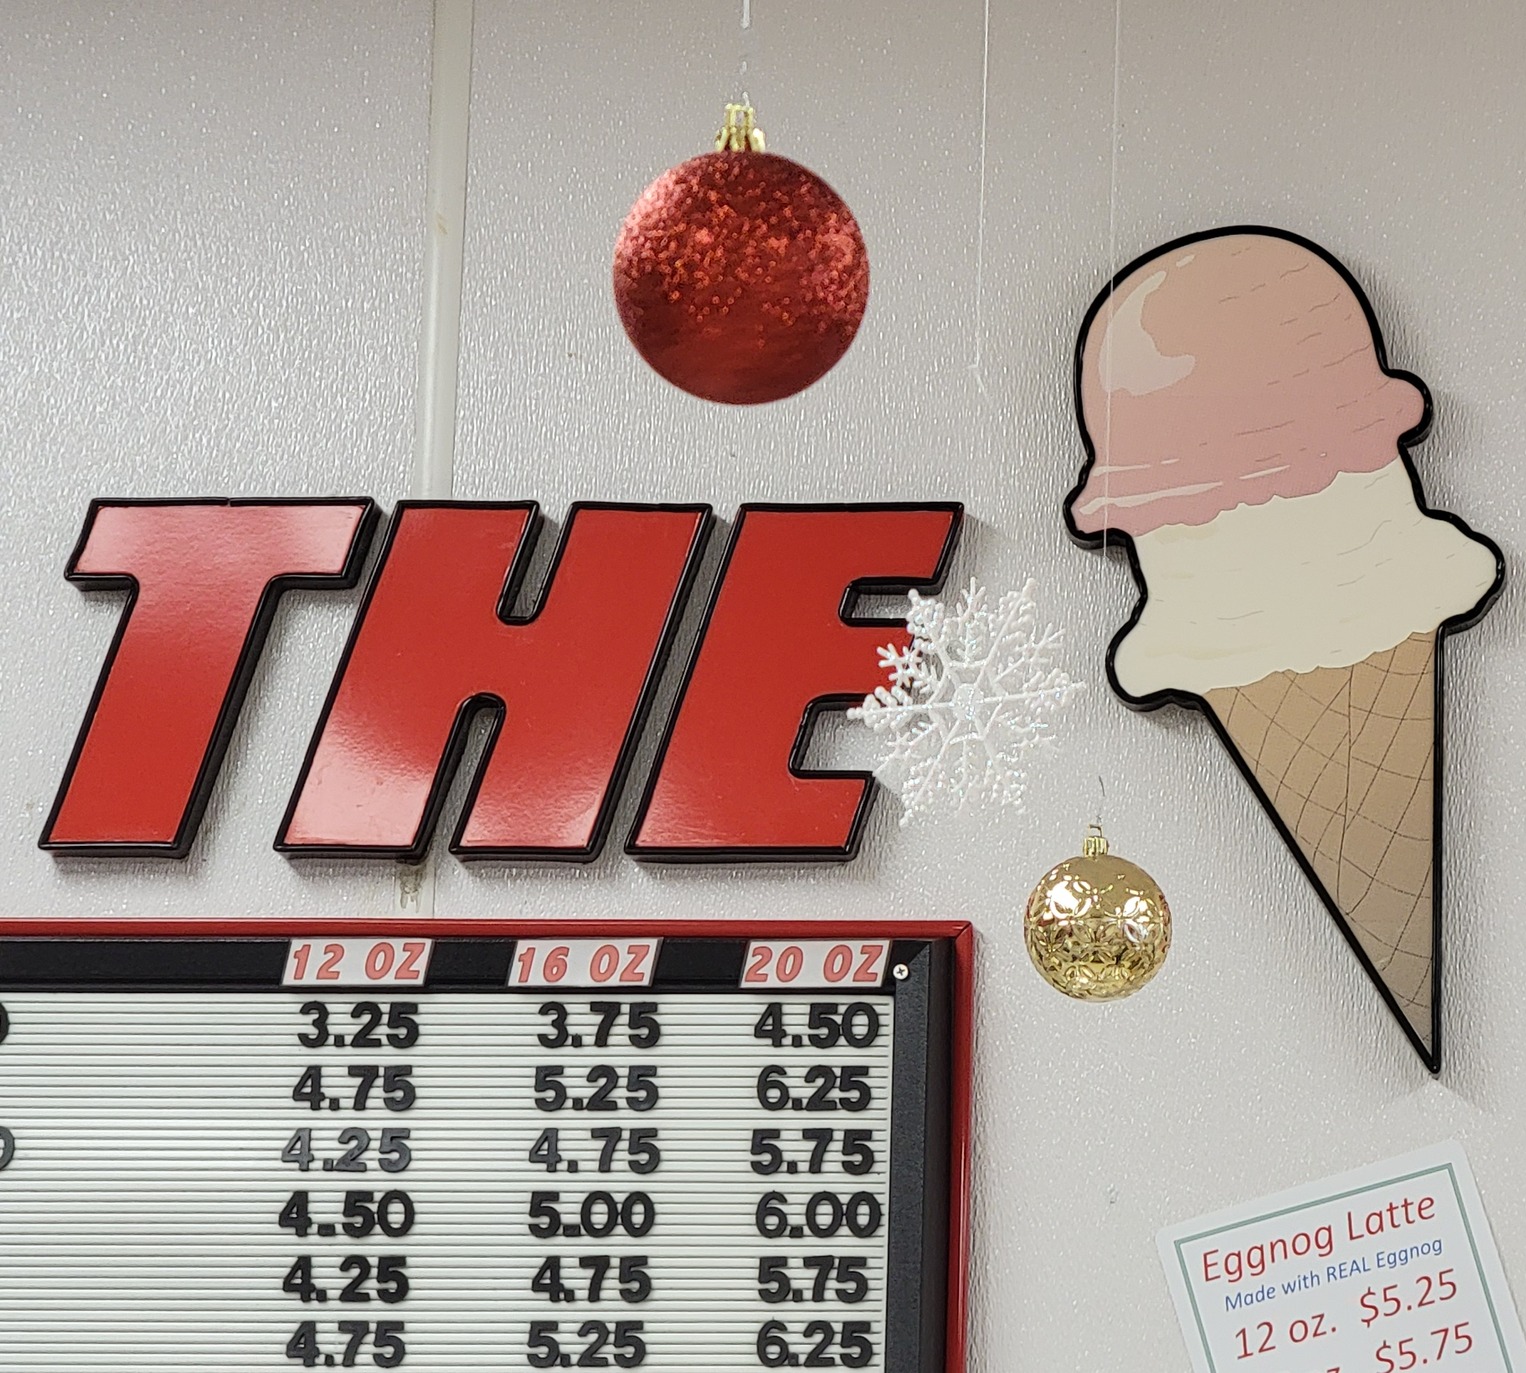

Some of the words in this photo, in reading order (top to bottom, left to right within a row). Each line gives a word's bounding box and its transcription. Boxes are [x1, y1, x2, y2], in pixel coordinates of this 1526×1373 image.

[38, 497, 963, 864] THE
[293, 943, 344, 980] 12
[365, 942, 425, 980] OZ
[518, 946, 569, 982] 16
[590, 944, 649, 982] OZ
[744, 945, 803, 982] 20
[823, 944, 883, 982] OZ
[298, 1001, 419, 1048] 3.25
[538, 1001, 660, 1048] 3.75
[754, 1001, 879, 1048] 4.50
[292, 1065, 415, 1111] 4.75
[534, 1065, 658, 1111] 5.25
[757, 1065, 871, 1111] 6.25
[280, 1127, 411, 1173] 4.25
[529, 1127, 660, 1173] 4.75
[751, 1127, 874, 1173] 5.75
[279, 1190, 414, 1238] 4.50
[529, 1190, 655, 1238] 5.00
[755, 1190, 881, 1238] 6.00
[1203, 1225, 1334, 1284] Eggnog
[1347, 1197, 1436, 1241] Latte
[283, 1255, 409, 1303] 4.25
[532, 1255, 651, 1303] 4.75
[759, 1255, 868, 1303] 5.75
[1225, 1286, 1276, 1312] Made
[1281, 1270, 1321, 1296] with
[1327, 1258, 1371, 1282] REAL
[1377, 1239, 1443, 1269] Eggnog
[1235, 1322, 1277, 1359] 12
[1288, 1313, 1337, 1343] oz.
[1360, 1269, 1458, 1328] $5.25
[286, 1319, 406, 1368] 4.75
[527, 1319, 646, 1368] 5.25
[756, 1319, 873, 1368] 6.25
[1376, 1322, 1473, 1373] $5.75
